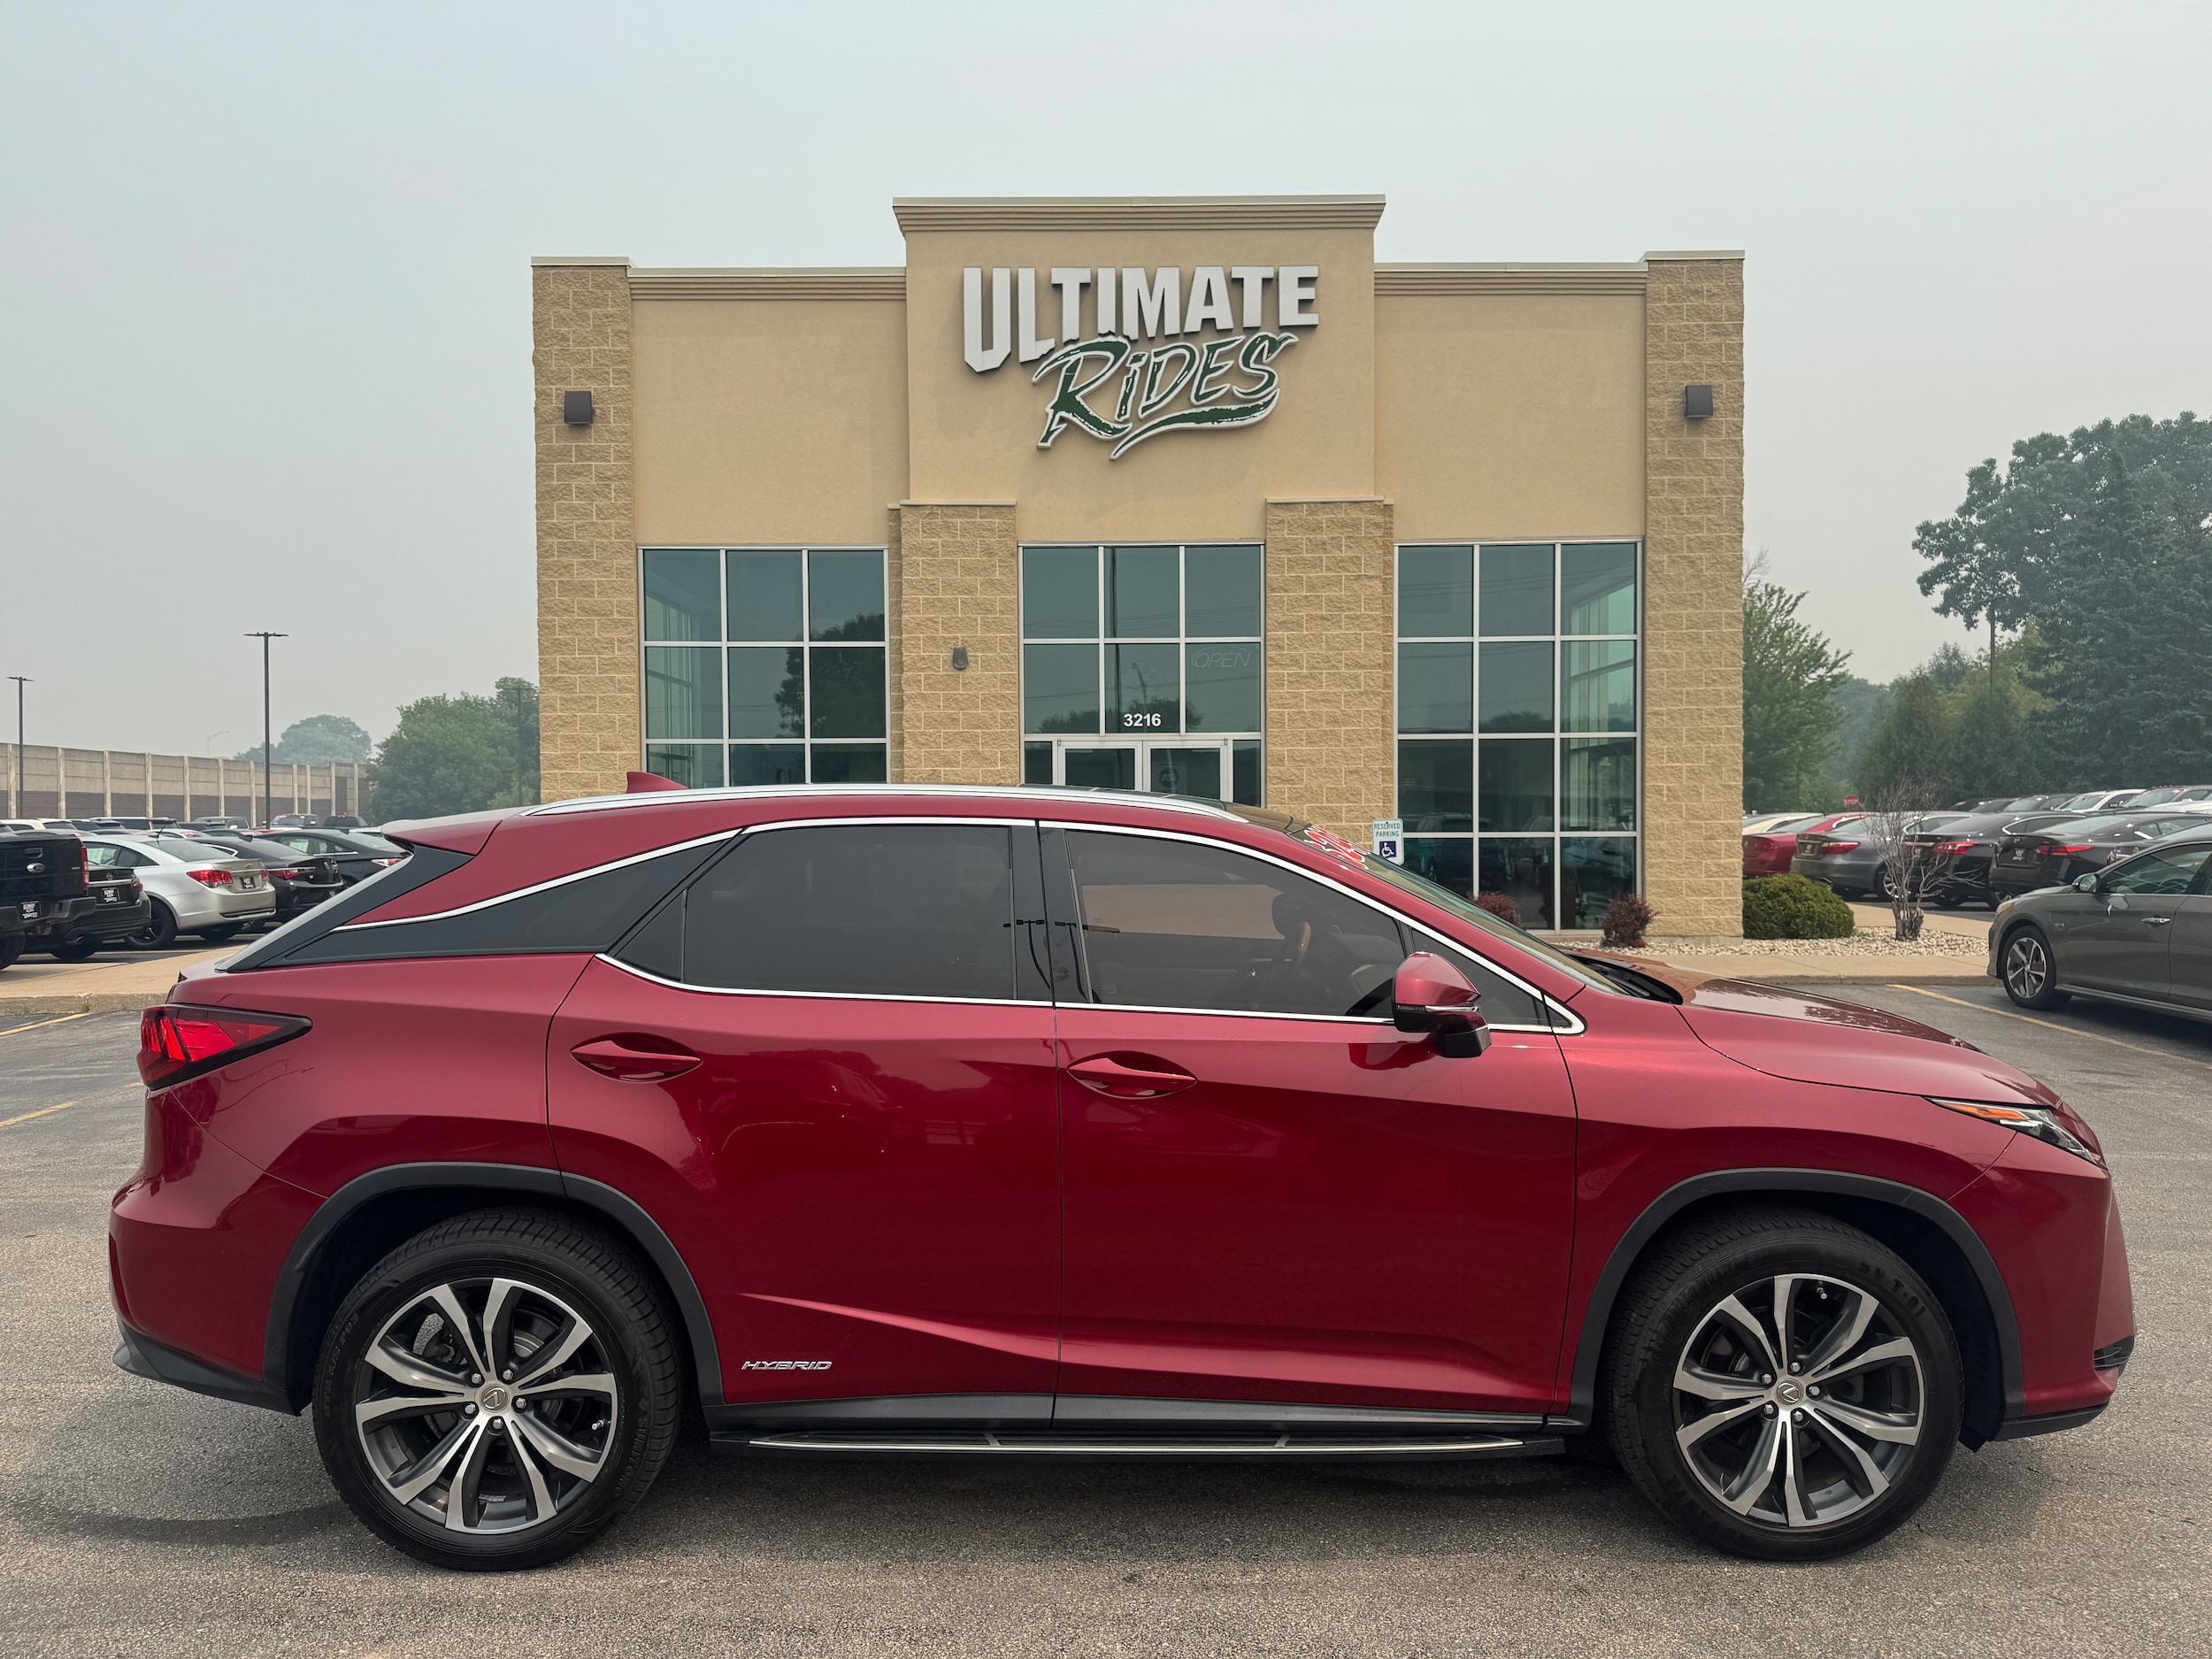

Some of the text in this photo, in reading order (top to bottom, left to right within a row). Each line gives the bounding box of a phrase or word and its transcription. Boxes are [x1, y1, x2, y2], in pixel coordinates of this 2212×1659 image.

[964, 265, 1319, 373] ULTIMATE
[1194, 651, 1251, 668] OPEN
[1123, 712, 1162, 726] 3216
[741, 1361, 833, 1371] HYBRID
